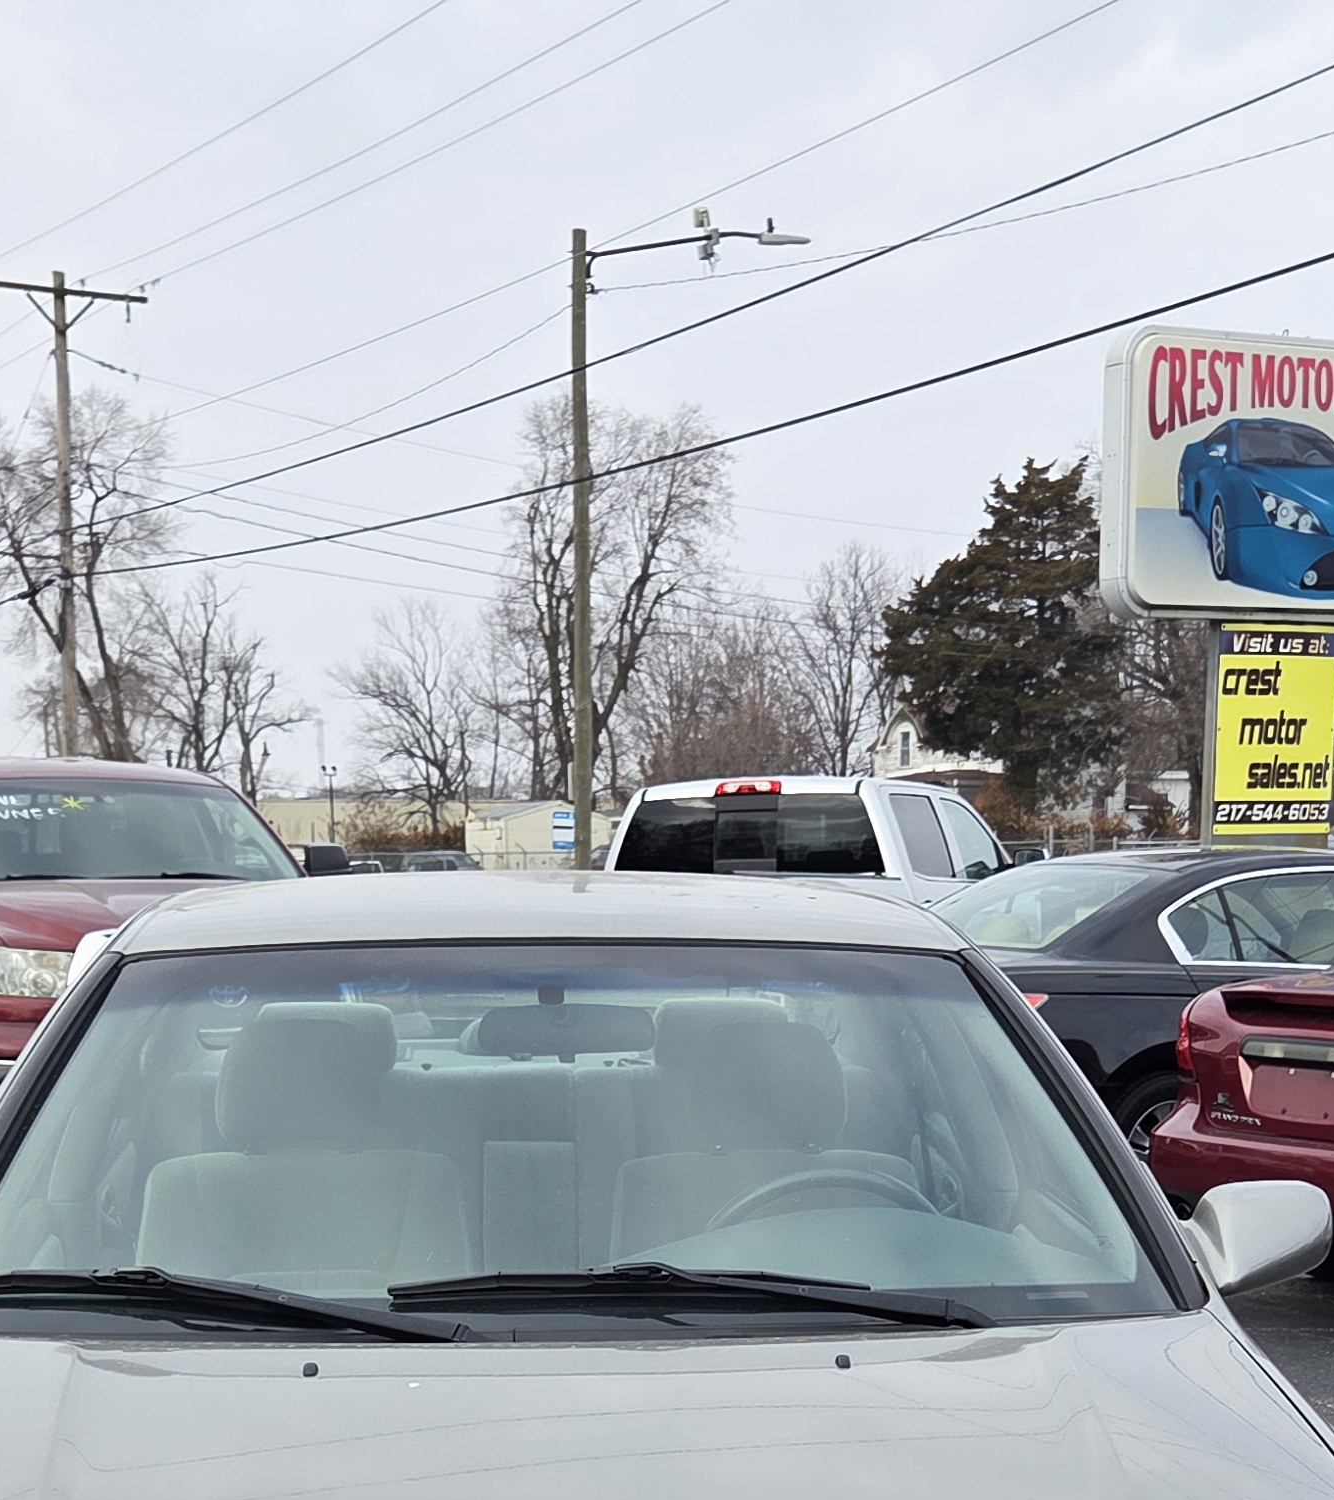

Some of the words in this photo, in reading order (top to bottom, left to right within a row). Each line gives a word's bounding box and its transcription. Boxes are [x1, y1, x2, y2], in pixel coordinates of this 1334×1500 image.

[1148, 345, 1244, 440] CREST
[1233, 634, 1274, 653] Visit
[1278, 638, 1303, 653] us
[1308, 636, 1330, 654] at:
[1222, 661, 1282, 696] crest
[1239, 710, 1307, 745] motor
[1246, 754, 1330, 789] sales.net
[1216, 804, 1330, 821] 217-544-6053
